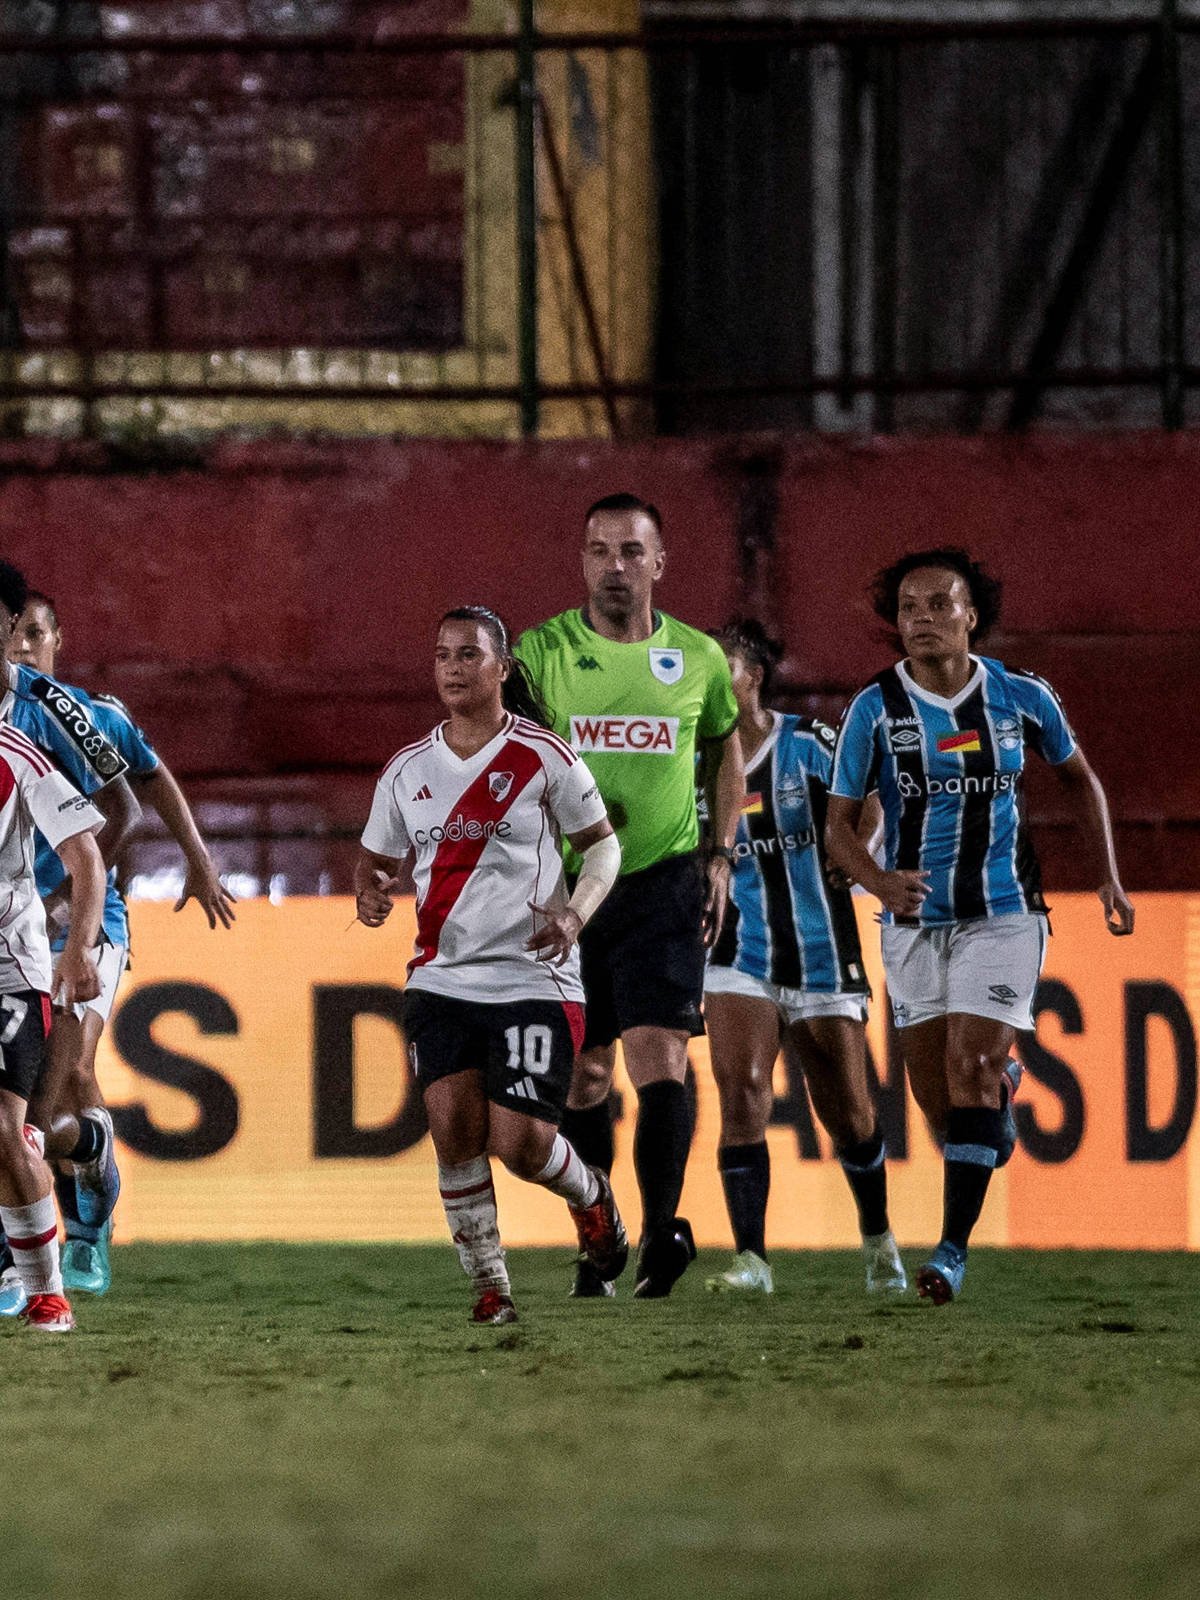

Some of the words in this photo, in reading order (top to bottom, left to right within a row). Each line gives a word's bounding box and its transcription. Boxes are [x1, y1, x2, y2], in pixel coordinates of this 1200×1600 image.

[46, 686, 92, 737] vero
[574, 718, 672, 749] WEGA
[414, 813, 513, 846] codere
[504, 1023, 552, 1075] 10
